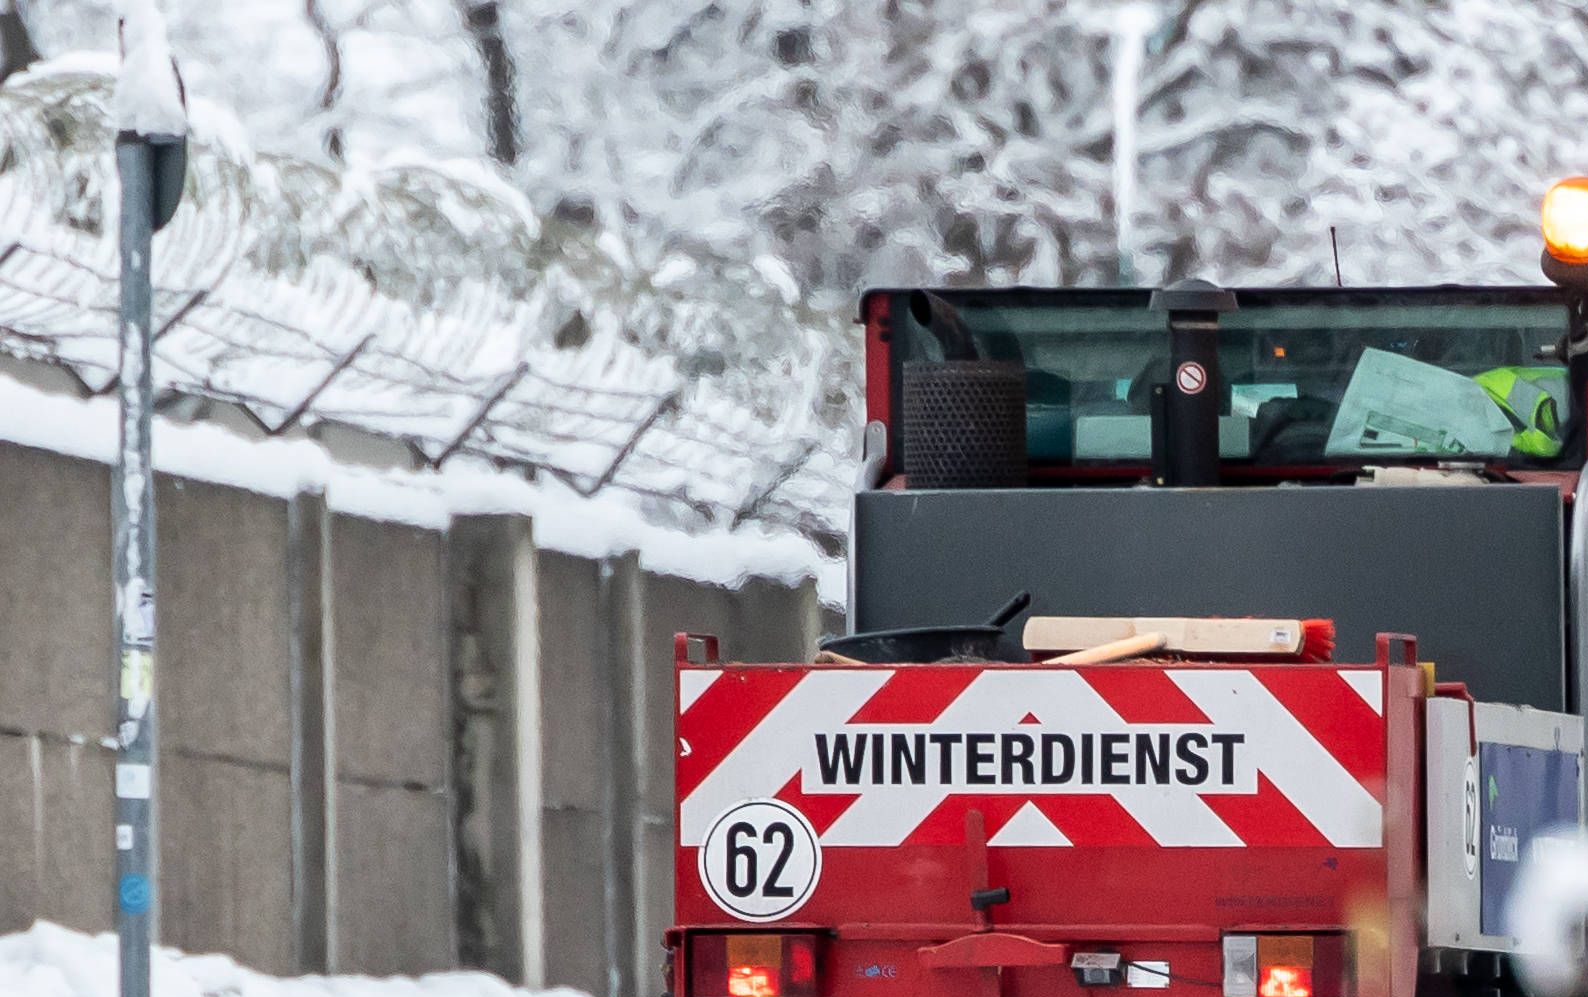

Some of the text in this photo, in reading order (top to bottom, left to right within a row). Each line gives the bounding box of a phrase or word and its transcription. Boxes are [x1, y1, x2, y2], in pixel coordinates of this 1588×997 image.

[814, 732, 1245, 786] WINTERDIENST
[1465, 780, 1476, 856] 62
[726, 821, 794, 898] 62
